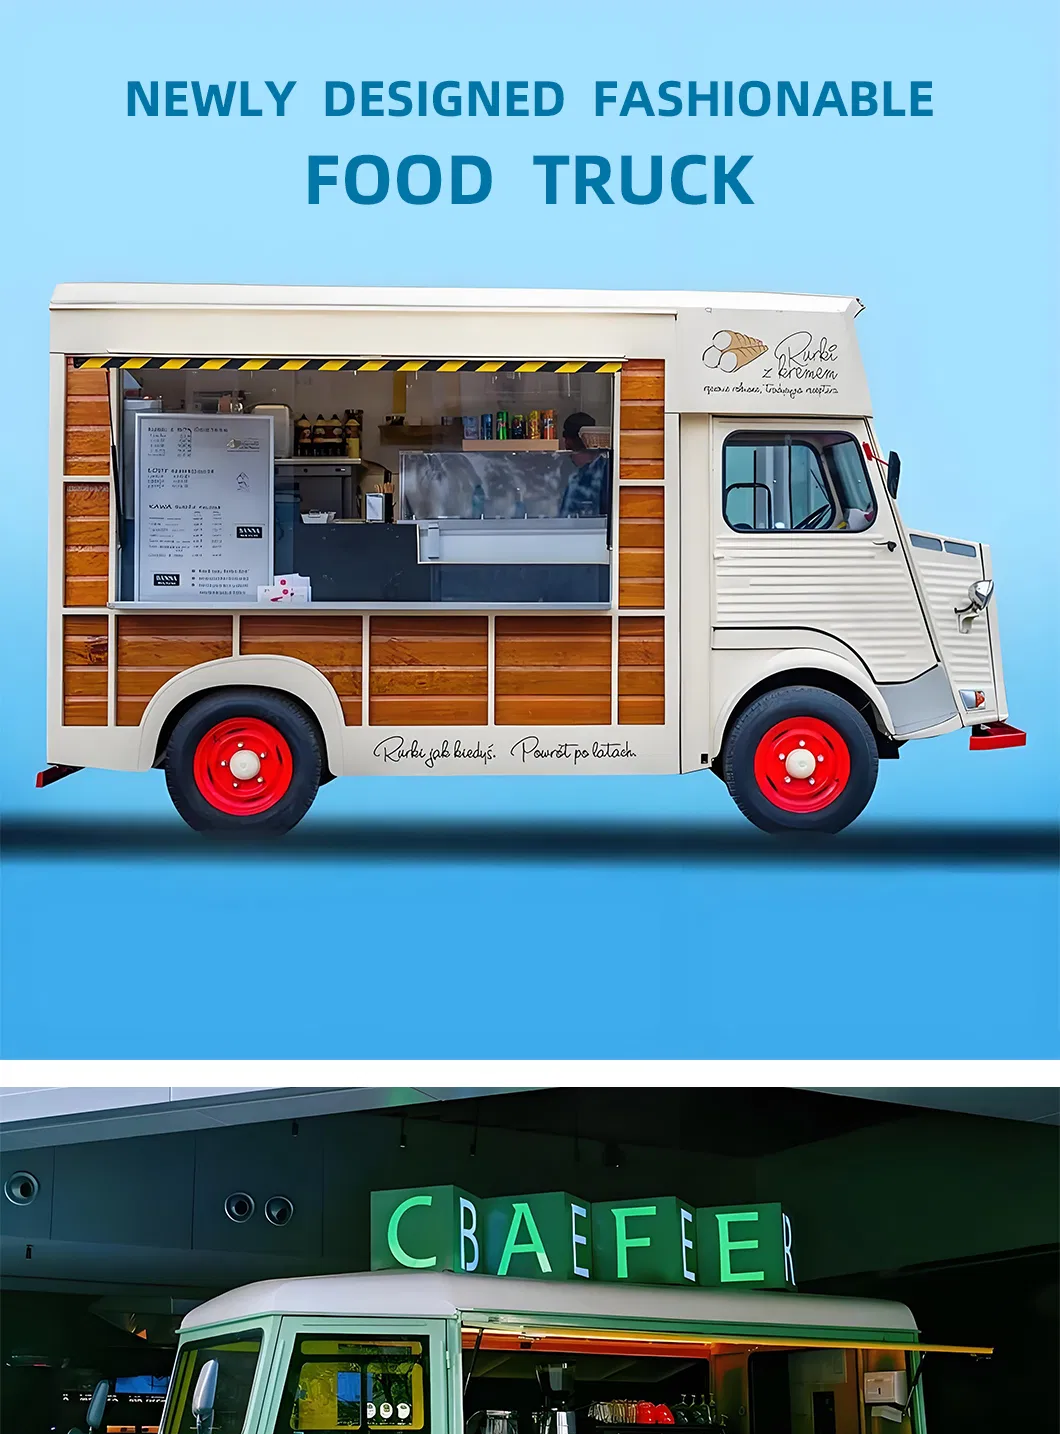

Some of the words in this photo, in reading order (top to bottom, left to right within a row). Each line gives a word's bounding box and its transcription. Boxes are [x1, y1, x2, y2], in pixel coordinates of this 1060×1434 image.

[774, 331, 838, 368] Rurki
[778, 354, 839, 380] kremem
[373, 735, 426, 763] Rurki
[424, 739, 451, 769] jak
[453, 739, 497, 765] kiedyś.
[510, 735, 579, 763] Powrót
[574, 748, 590, 765] po
